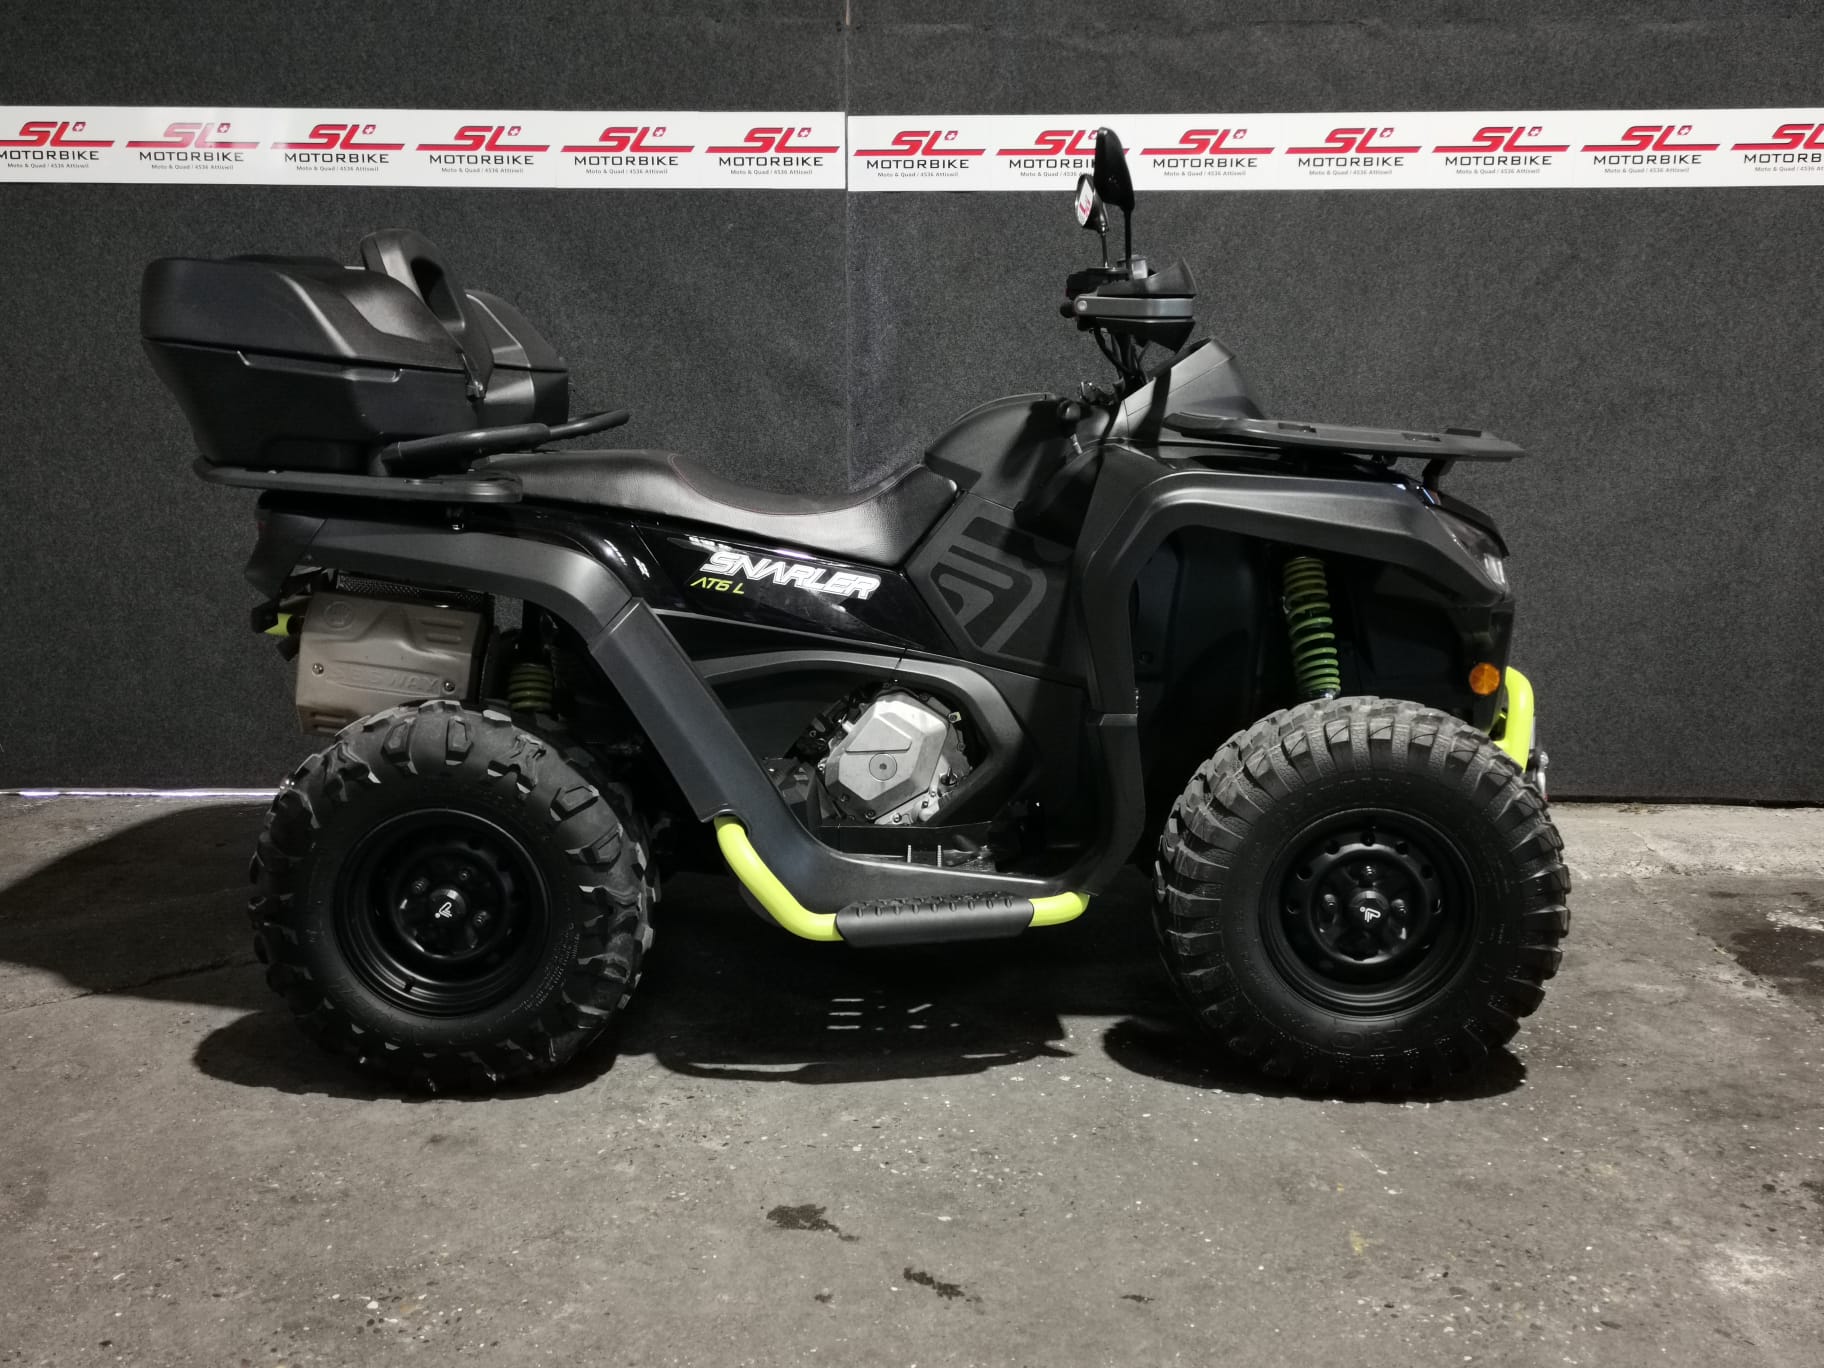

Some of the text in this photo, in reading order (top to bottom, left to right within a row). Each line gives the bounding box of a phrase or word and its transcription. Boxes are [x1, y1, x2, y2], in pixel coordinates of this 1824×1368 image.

[140, 152, 244, 161] MOTORBIKE
[285, 153, 389, 163] MOTORBIKE
[430, 155, 534, 165] MOTORBIKE
[574, 156, 679, 166] MOTORBIKE
[719, 157, 823, 166] MOTORBIKE
[1445, 156, 1552, 166] MOTORBIKE
[1594, 155, 1702, 165] MOTORBIKE
[1744, 153, 1823, 163] MOTORB
[867, 159, 970, 169] MOTORBIKE
[1009, 159, 1095, 168] MOTORBI
[1153, 158, 1258, 168] MOTORBIKE
[1298, 157, 1404, 167] MOTORBIKE
[699, 551, 881, 600] SNARLER
[690, 576, 744, 595] AT6 L
